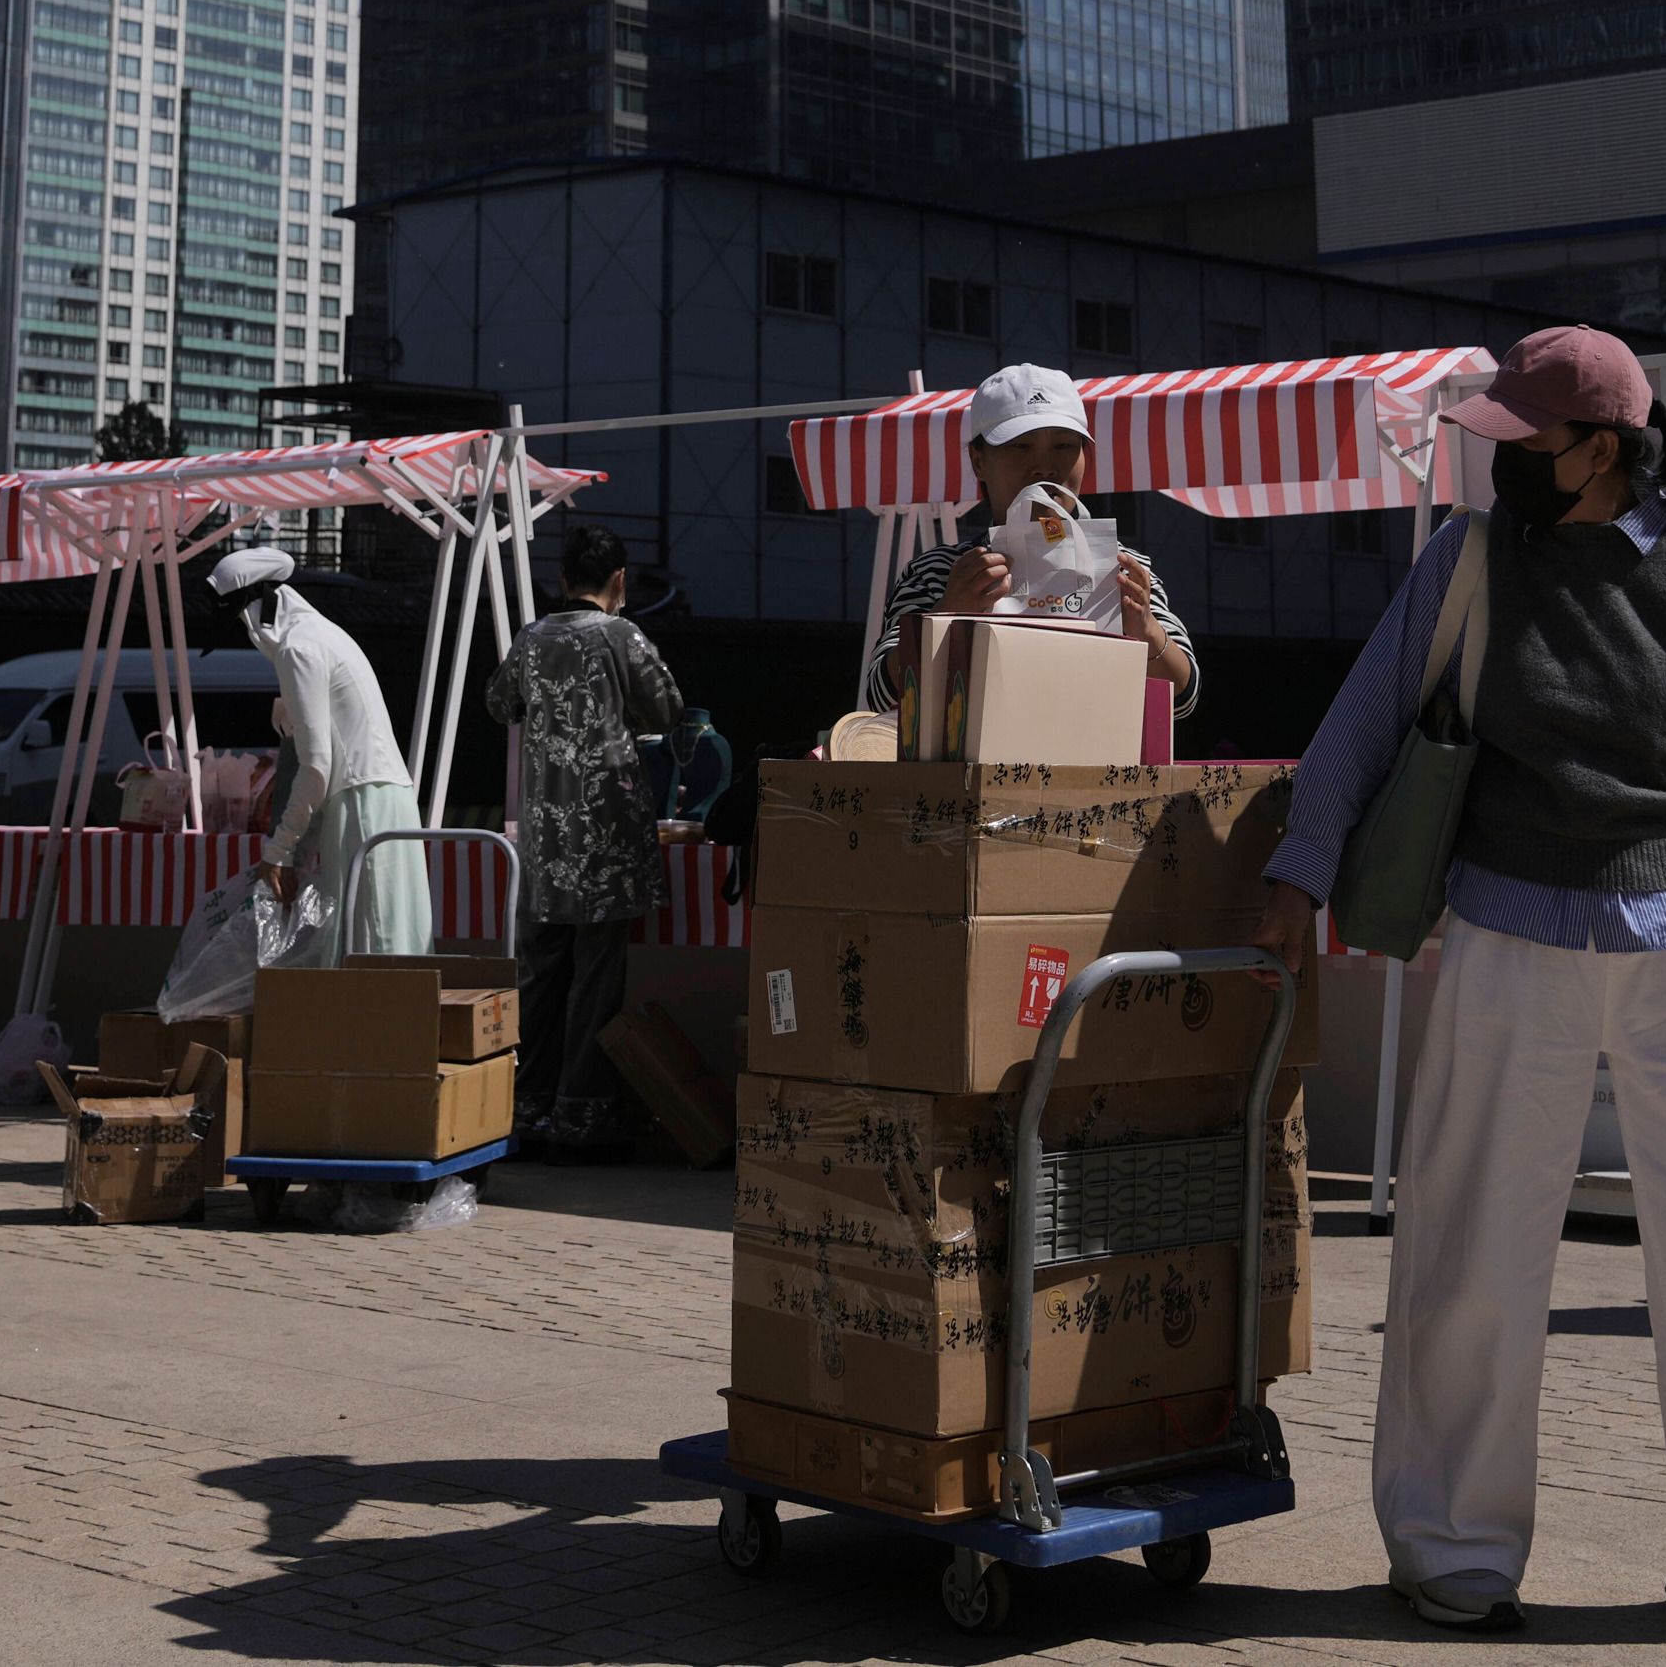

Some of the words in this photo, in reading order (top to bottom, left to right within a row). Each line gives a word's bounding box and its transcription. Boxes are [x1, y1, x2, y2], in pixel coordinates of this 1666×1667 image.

[1028, 594, 1063, 608] CoCo
[811, 783, 864, 816] 唐饼家
[849, 831, 859, 850] 9
[1028, 957, 1066, 976] 易碎物品
